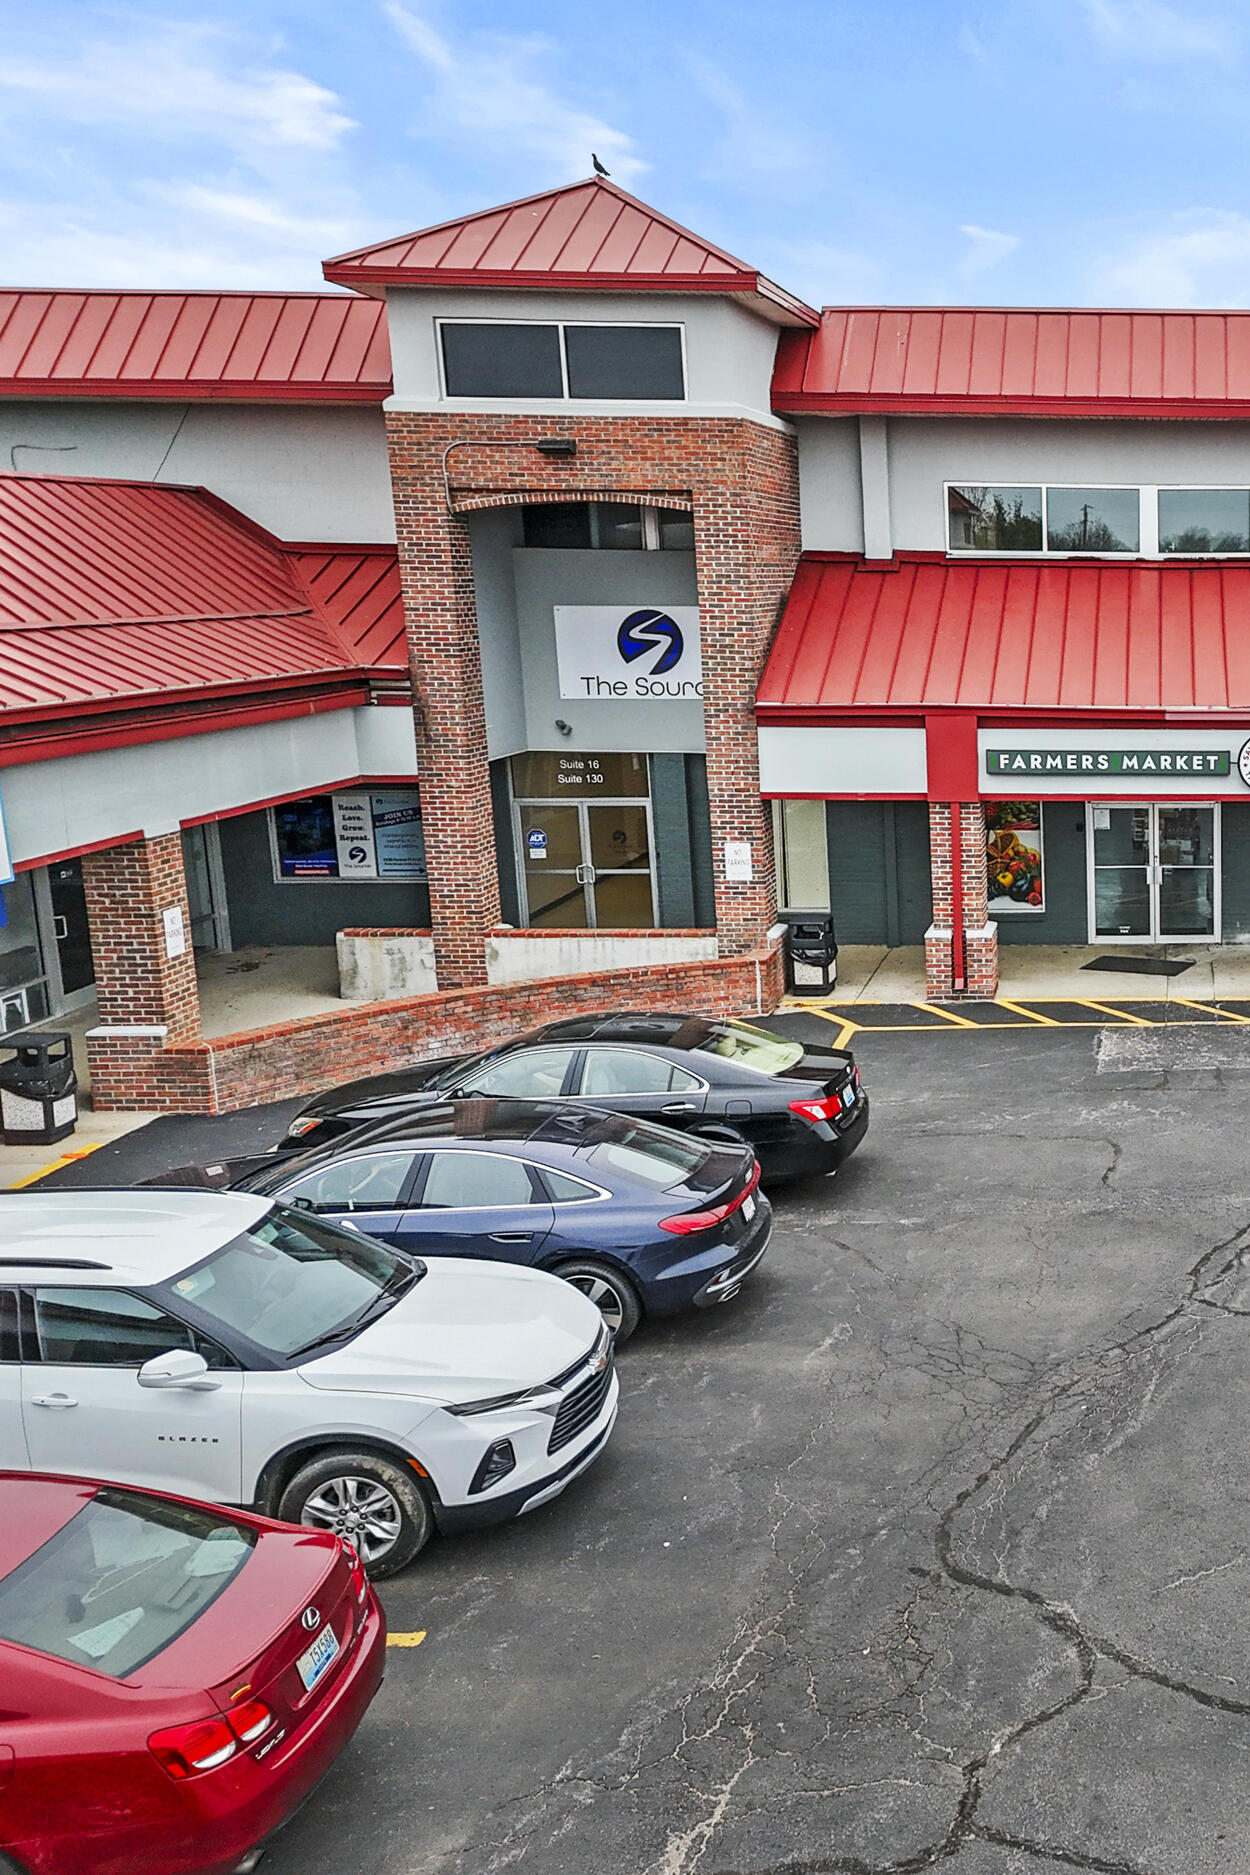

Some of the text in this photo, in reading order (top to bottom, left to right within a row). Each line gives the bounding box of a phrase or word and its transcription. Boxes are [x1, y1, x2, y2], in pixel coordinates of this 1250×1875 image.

[580, 675, 704, 697] The Sourc
[559, 759, 600, 769] Suite 16
[999, 754, 1219, 771] FARMERS MARKET
[557, 774, 604, 784] Suite 130
[383, 812, 402, 820] JOIN
[529, 834, 545, 842] ADT
[157, 1435, 220, 1443] BLAZER
